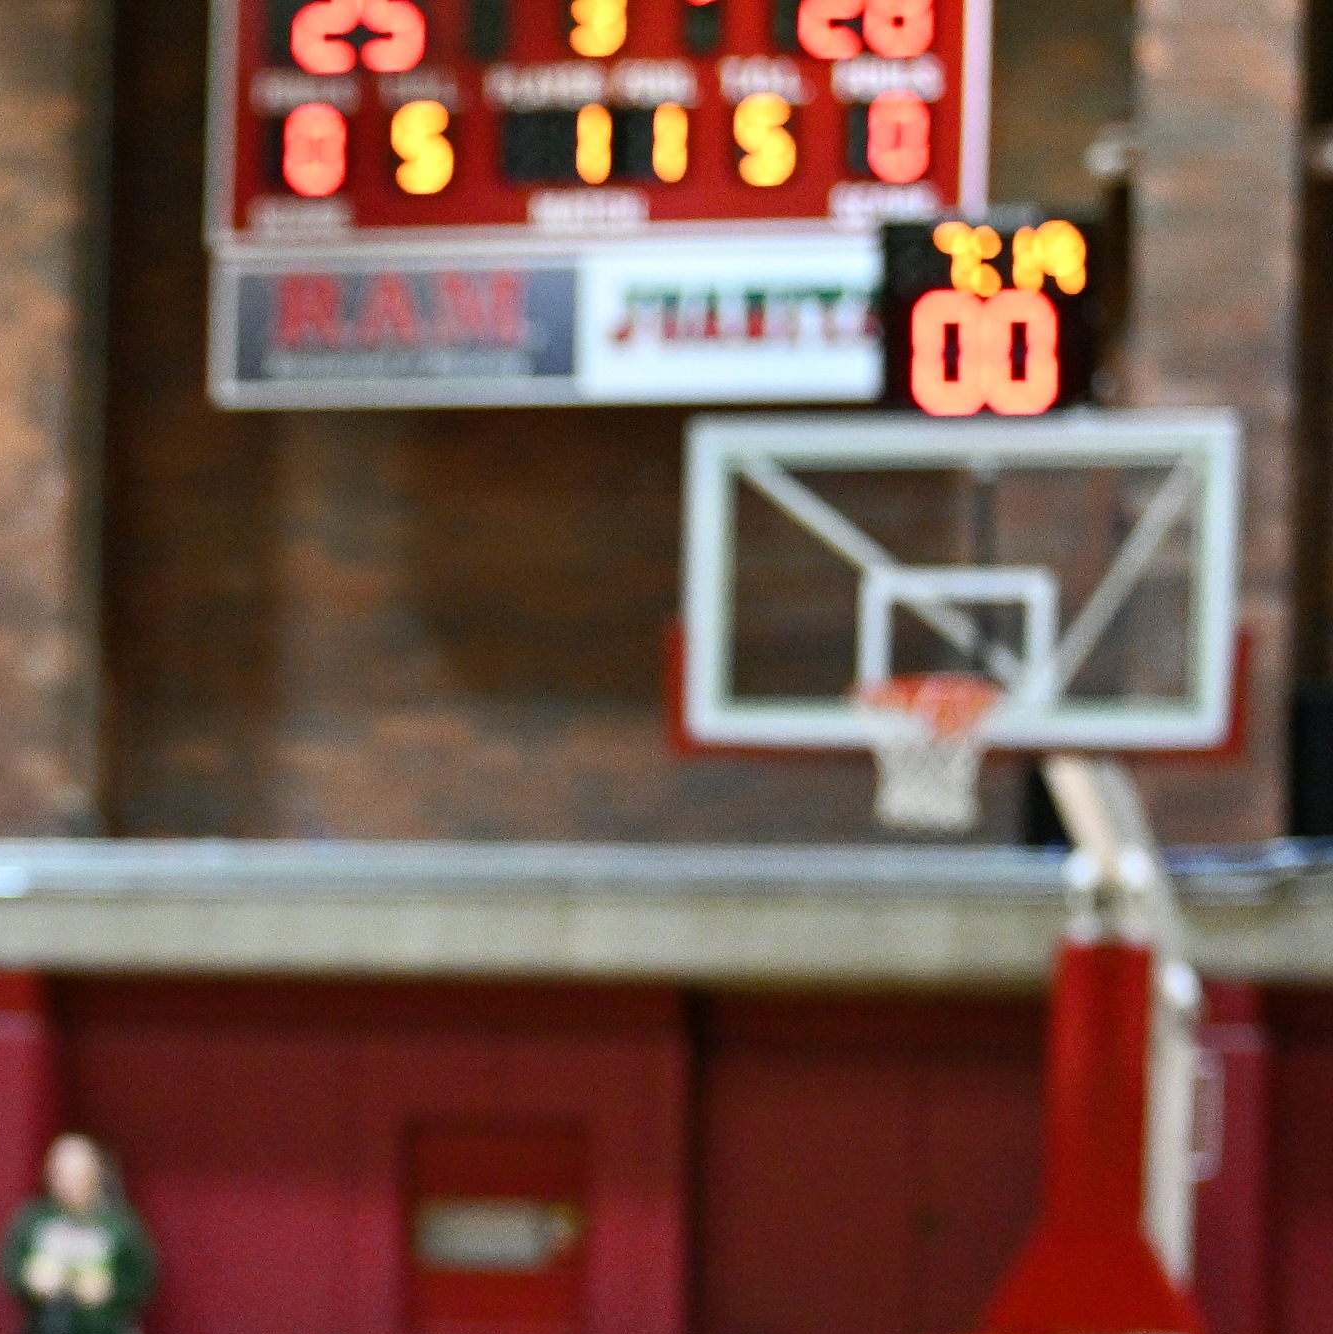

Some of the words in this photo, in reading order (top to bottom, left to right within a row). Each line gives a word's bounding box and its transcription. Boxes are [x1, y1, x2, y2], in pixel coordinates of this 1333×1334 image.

[390, 100, 454, 194] 5
[734, 92, 797, 187] 5
[911, 290, 1059, 416] 00
